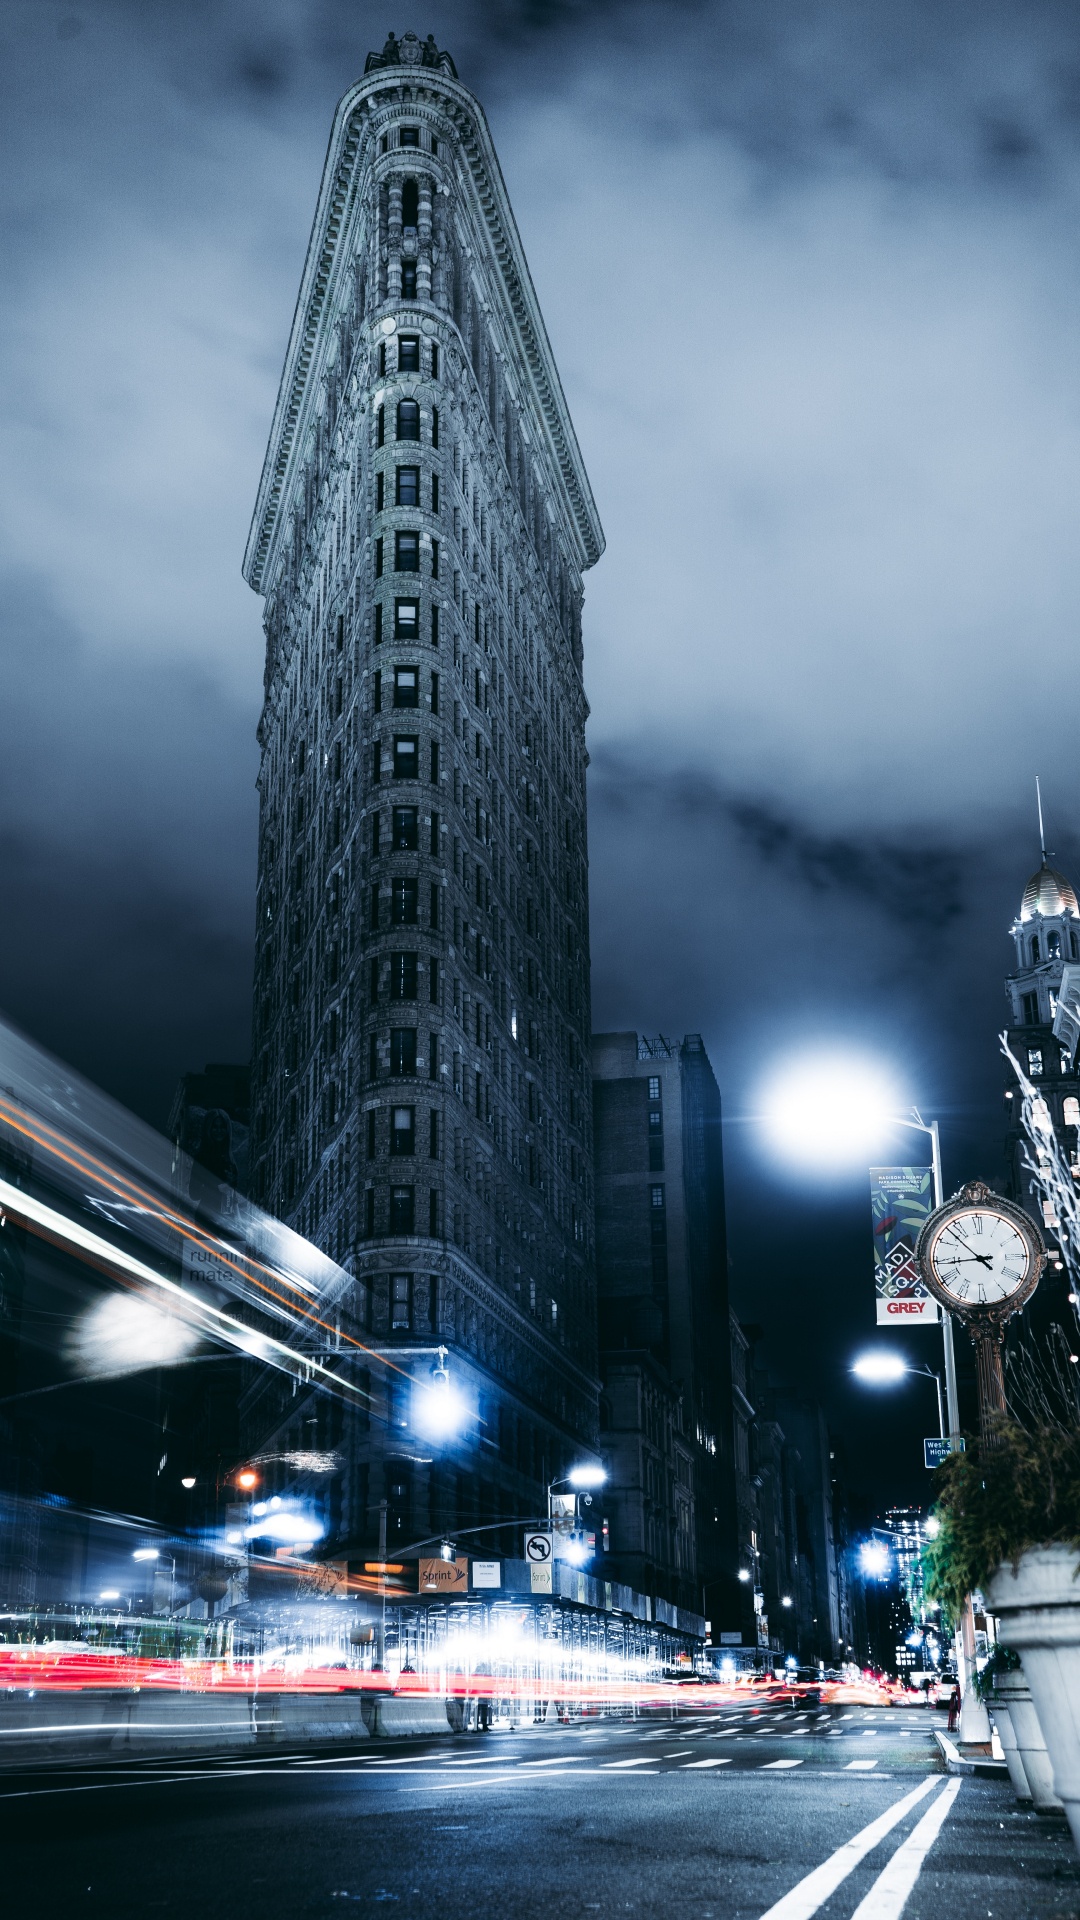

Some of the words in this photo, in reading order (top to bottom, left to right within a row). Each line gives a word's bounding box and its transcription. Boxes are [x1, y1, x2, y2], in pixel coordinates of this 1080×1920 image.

[190, 1268, 233, 1282] mate
[887, 1302, 926, 1314] GREY
[422, 1570, 452, 1583] Sprint
